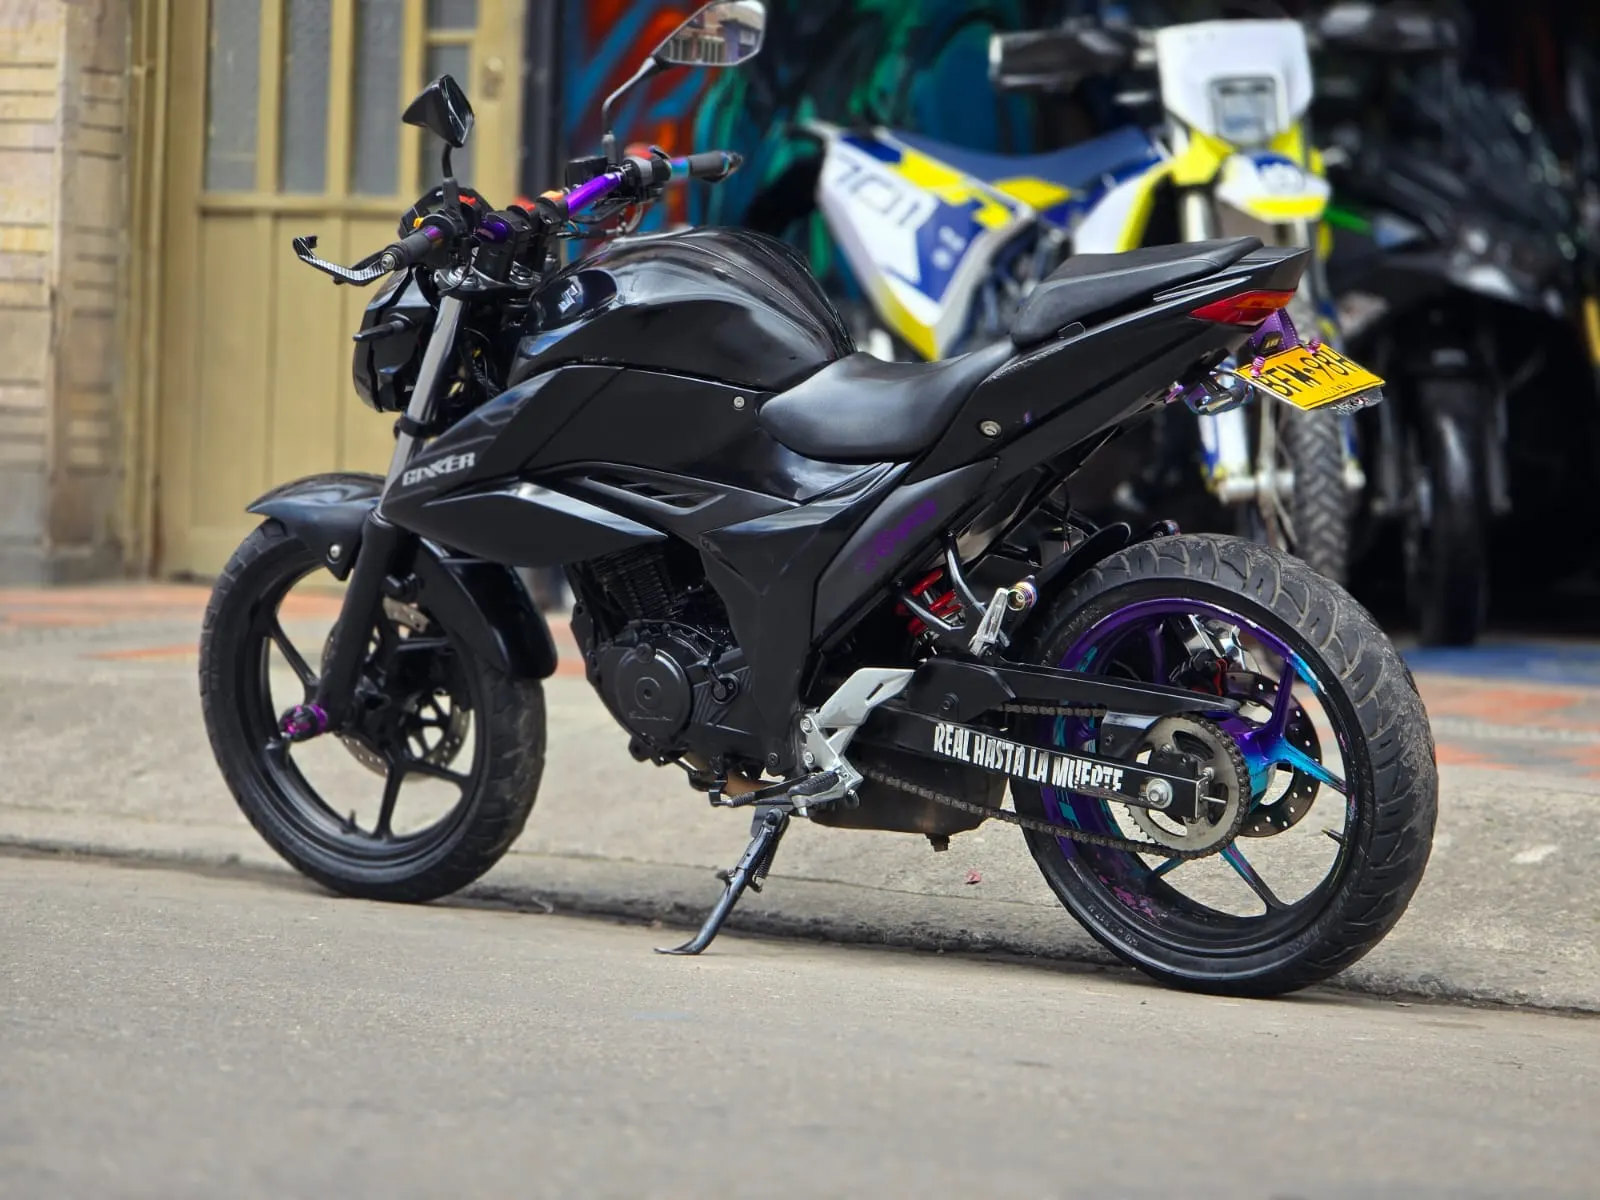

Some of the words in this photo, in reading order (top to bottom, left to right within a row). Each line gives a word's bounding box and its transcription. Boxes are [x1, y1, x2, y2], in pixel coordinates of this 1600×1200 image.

[933, 722, 971, 763] REAL
[973, 733, 1025, 778] HASTA
[1028, 748, 1050, 784] LA
